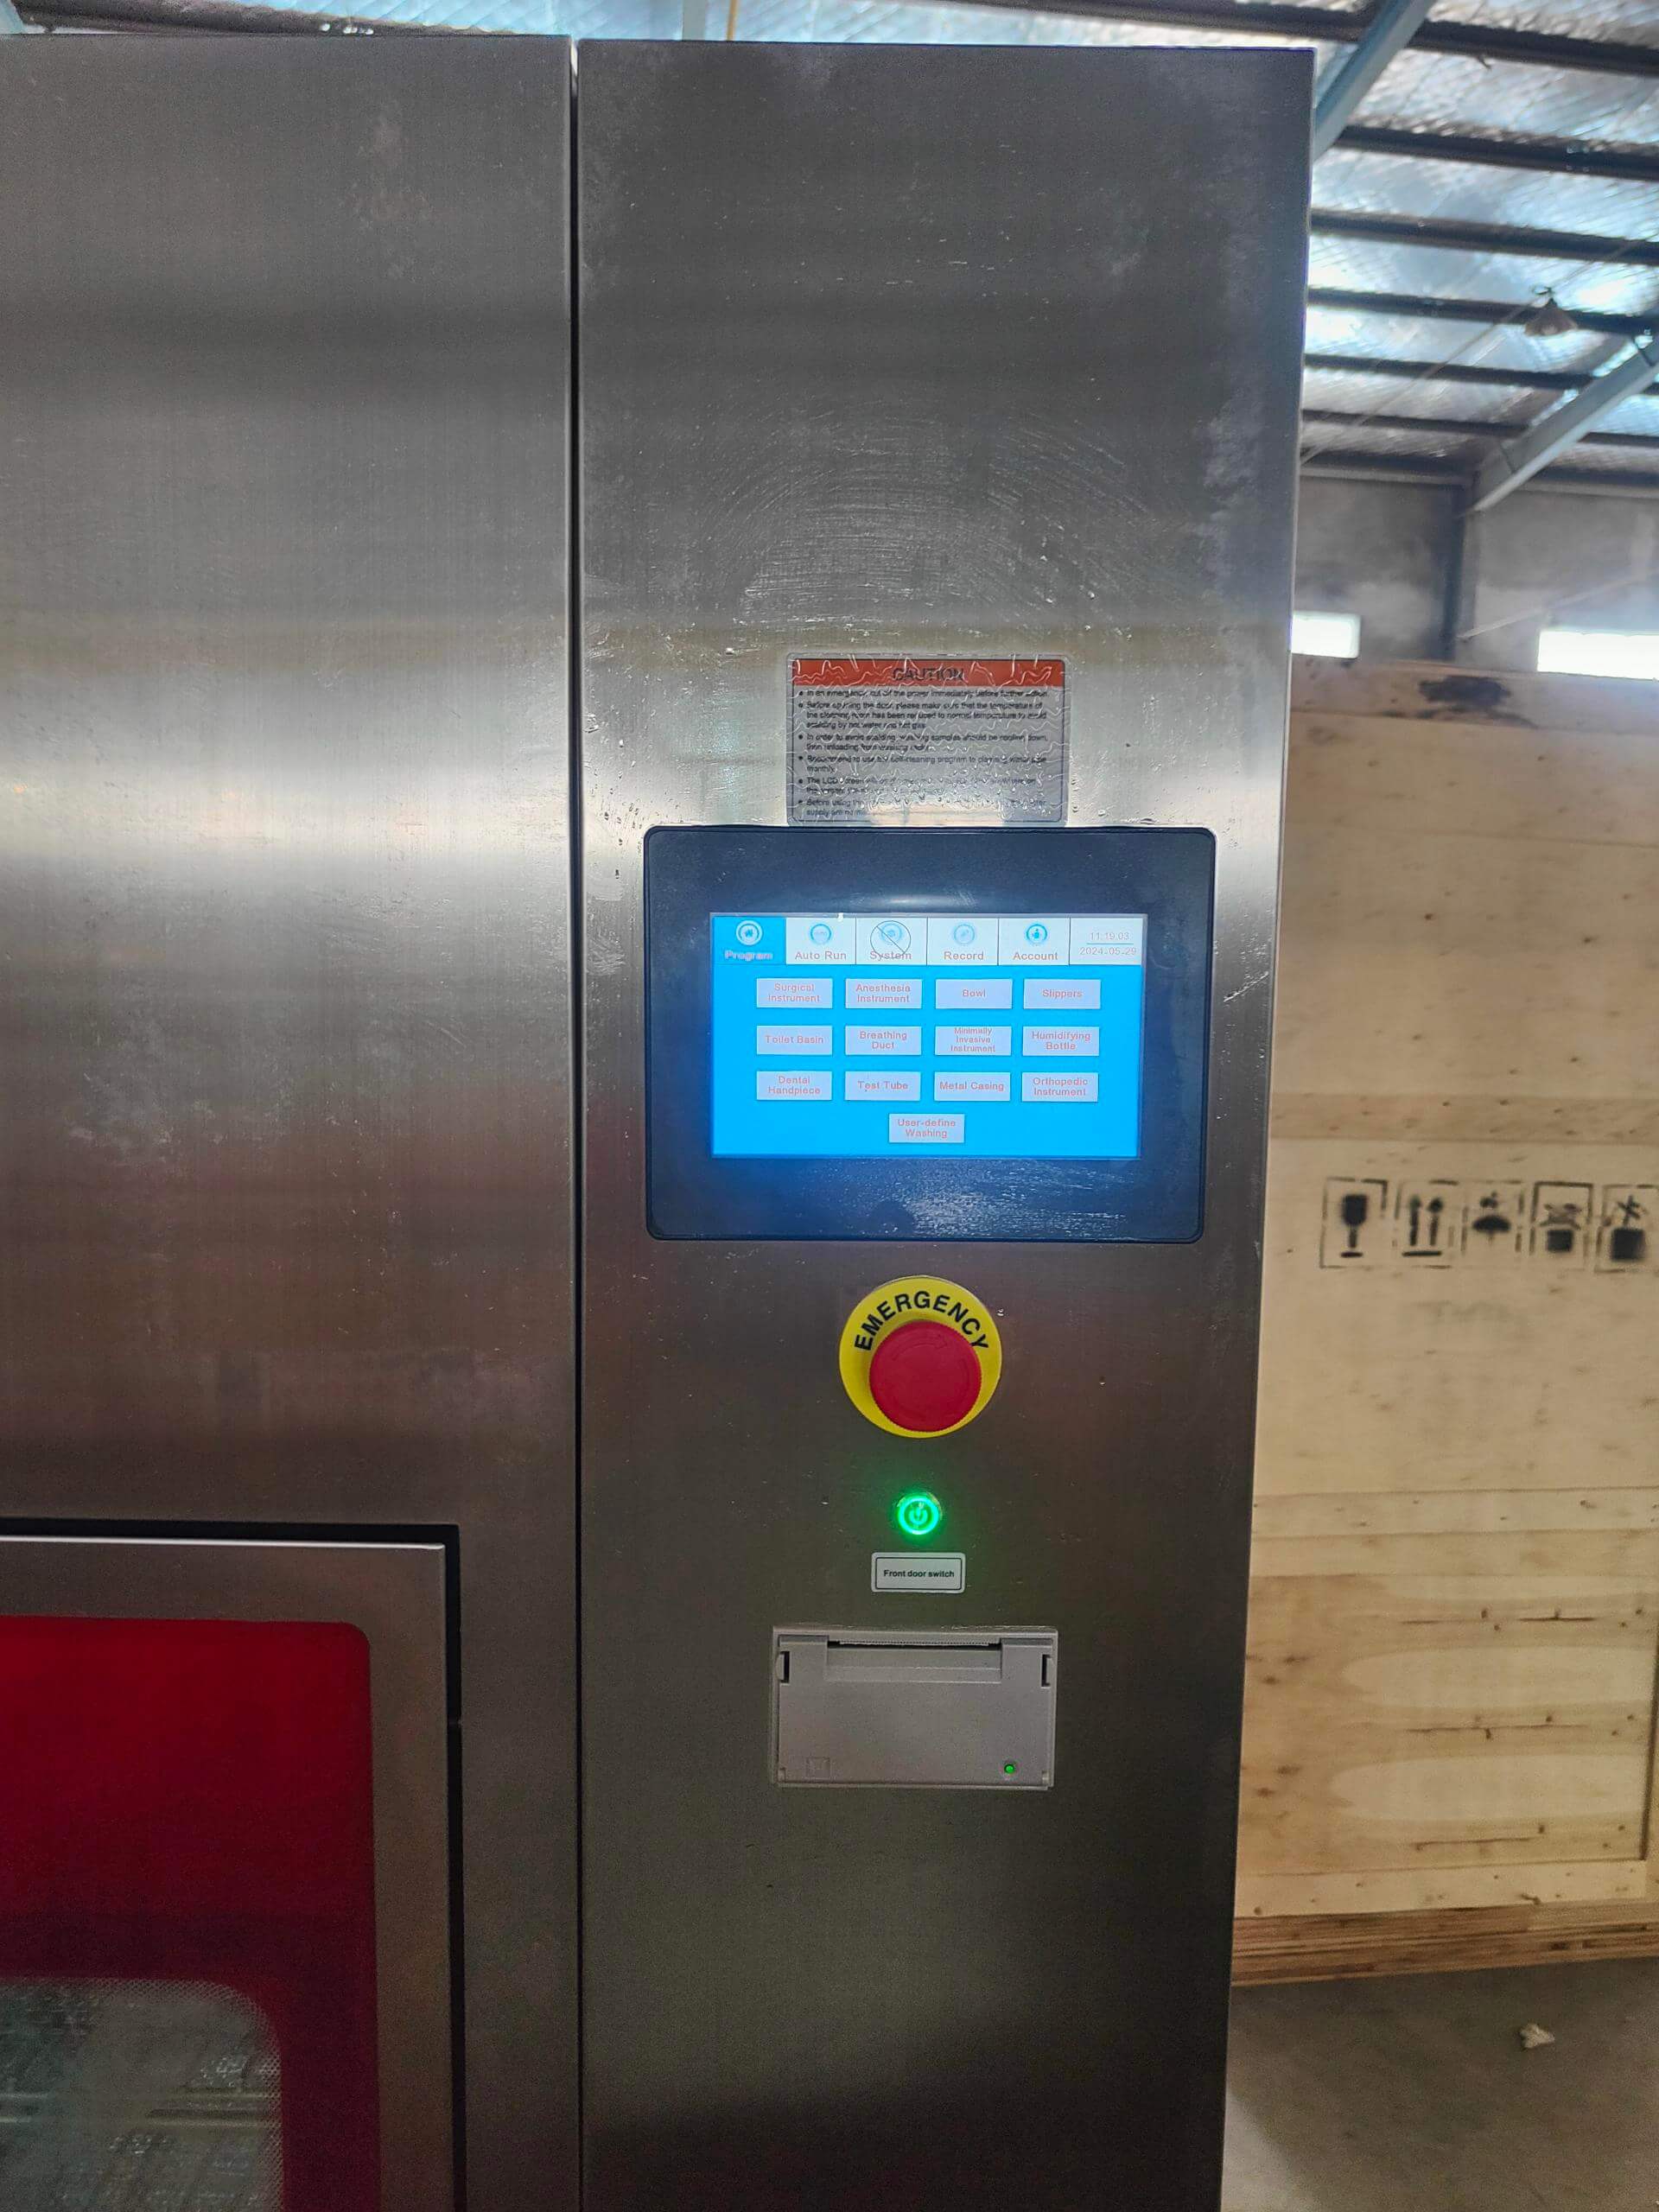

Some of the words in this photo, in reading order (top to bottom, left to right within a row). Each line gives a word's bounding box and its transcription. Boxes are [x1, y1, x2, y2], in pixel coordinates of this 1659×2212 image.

[893, 668, 964, 681] CAUTION
[724, 950, 773, 962] Program
[795, 950, 819, 961] Auto
[824, 950, 847, 961] Run
[869, 950, 912, 962] System
[944, 950, 984, 961] Record
[1013, 951, 1058, 962] Account
[774, 983, 815, 995] Surgical
[855, 984, 911, 993] Anesthesia
[768, 994, 820, 1002] Instrument
[857, 995, 910, 1003] Instrument
[1042, 989, 1082, 1000] Slippers
[860, 1031, 907, 1042] Breathing
[954, 1027, 992, 1036] Minimally
[766, 1035, 793, 1044] Toilet
[797, 1035, 824, 1044] Basin
[1032, 1032, 1090, 1043] Humidifying
[778, 1076, 810, 1084] Dental
[858, 1081, 880, 1090] Test
[883, 1081, 908, 1090] Tube
[1033, 1077, 1088, 1088] Orthopedic
[768, 1086, 820, 1096] Handpiece
[939, 1081, 966, 1090] Metal
[969, 1081, 1004, 1092] Casing
[1033, 1087, 1086, 1096] Instrument
[897, 1119, 956, 1128] User-define
[905, 1128, 947, 1139] Washing
[855, 1291, 988, 1351] EMERGENCY
